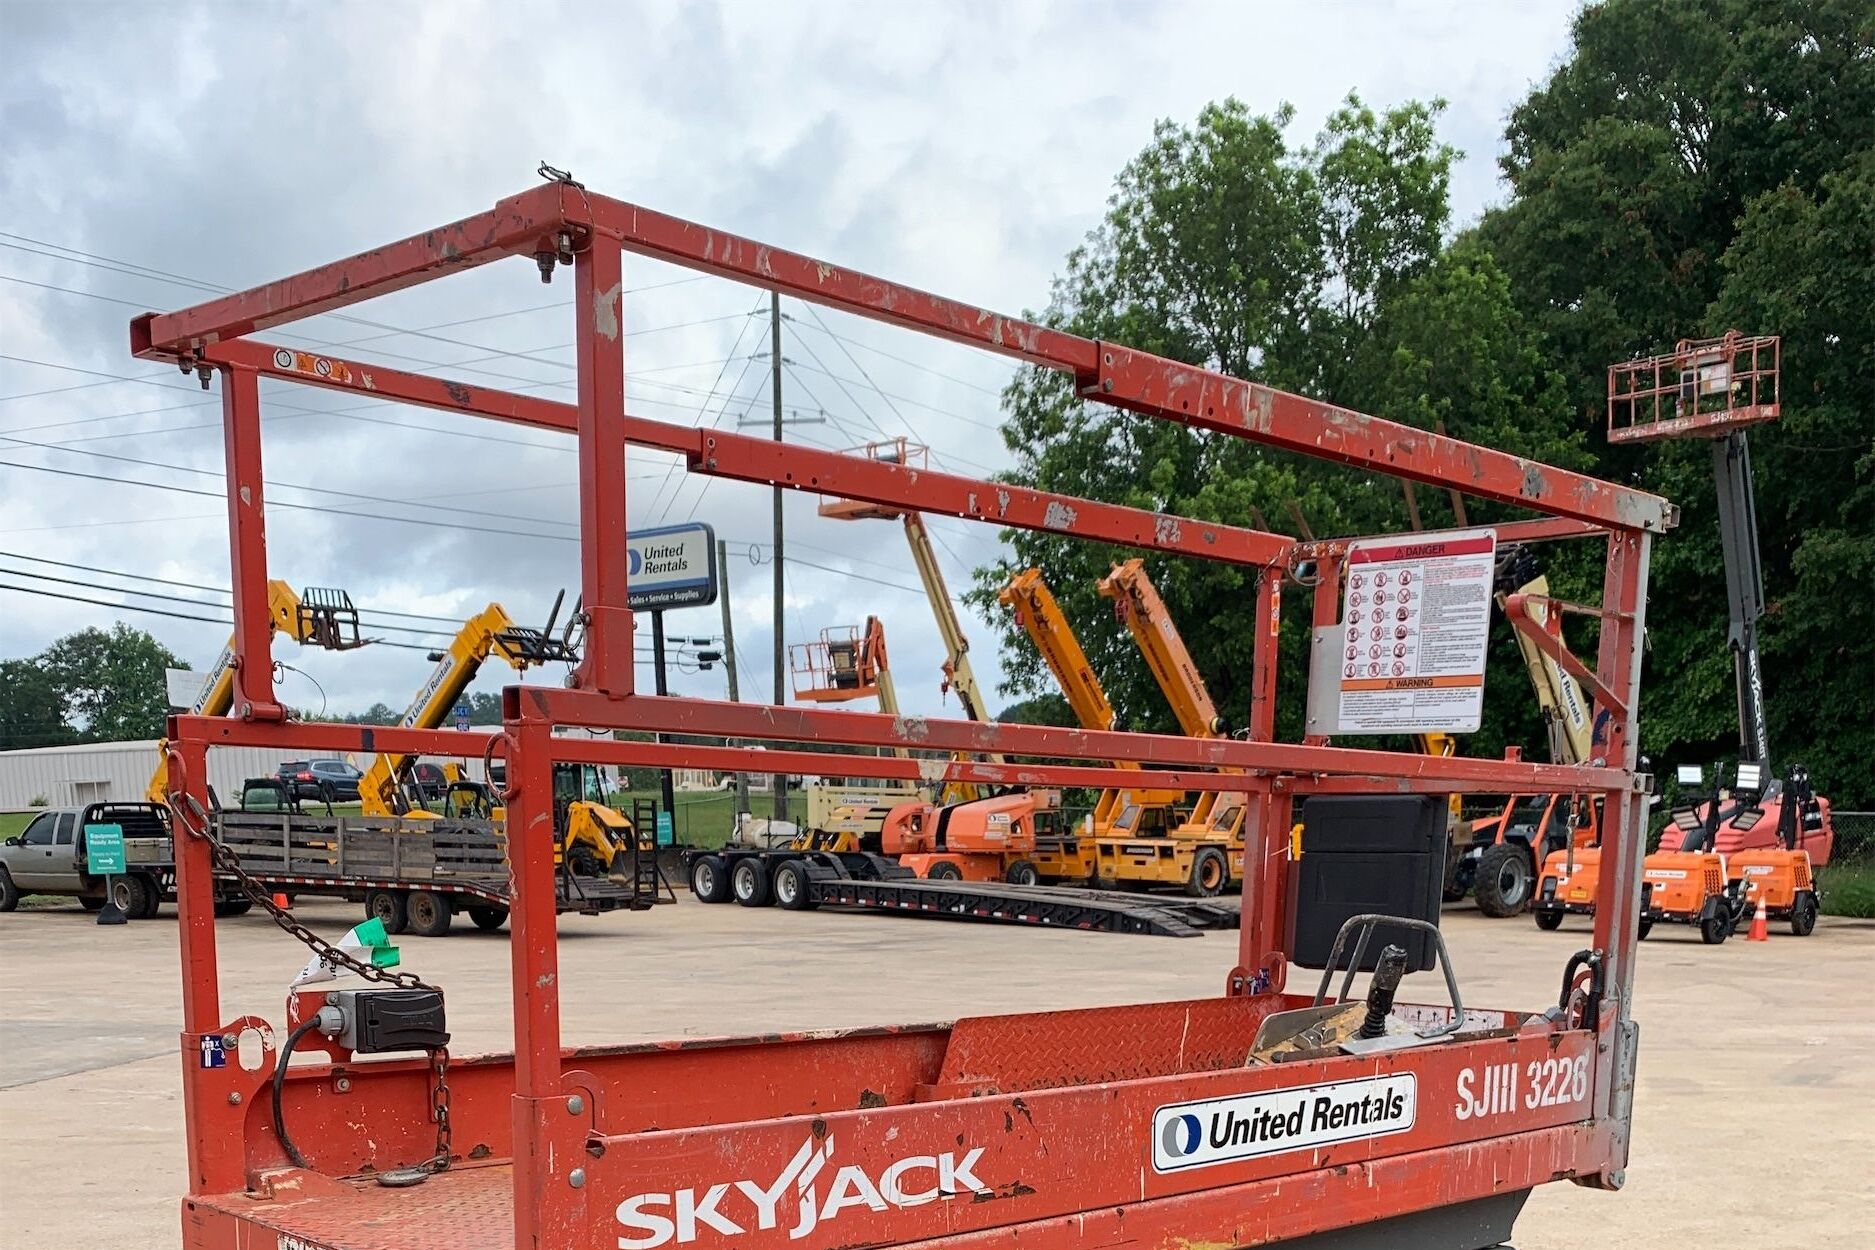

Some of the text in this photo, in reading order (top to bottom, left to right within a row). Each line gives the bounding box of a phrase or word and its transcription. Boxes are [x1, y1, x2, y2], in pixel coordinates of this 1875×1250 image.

[644, 542, 684, 560] United
[644, 558, 688, 575] Rentals
[1406, 544, 1446, 557] DANGER
[673, 589, 700, 601] Supplies
[200, 651, 231, 706] United Rentals
[412, 659, 452, 719] United Rentals
[1396, 678, 1434, 688] WARNING
[1563, 680, 1581, 725] Rentals
[1748, 649, 1762, 728] SKYJACK
[1455, 1051, 1588, 1121] SJIII 3226
[1209, 1087, 1405, 1149] United Rentals
[614, 1133, 994, 1250] SKYJACK
